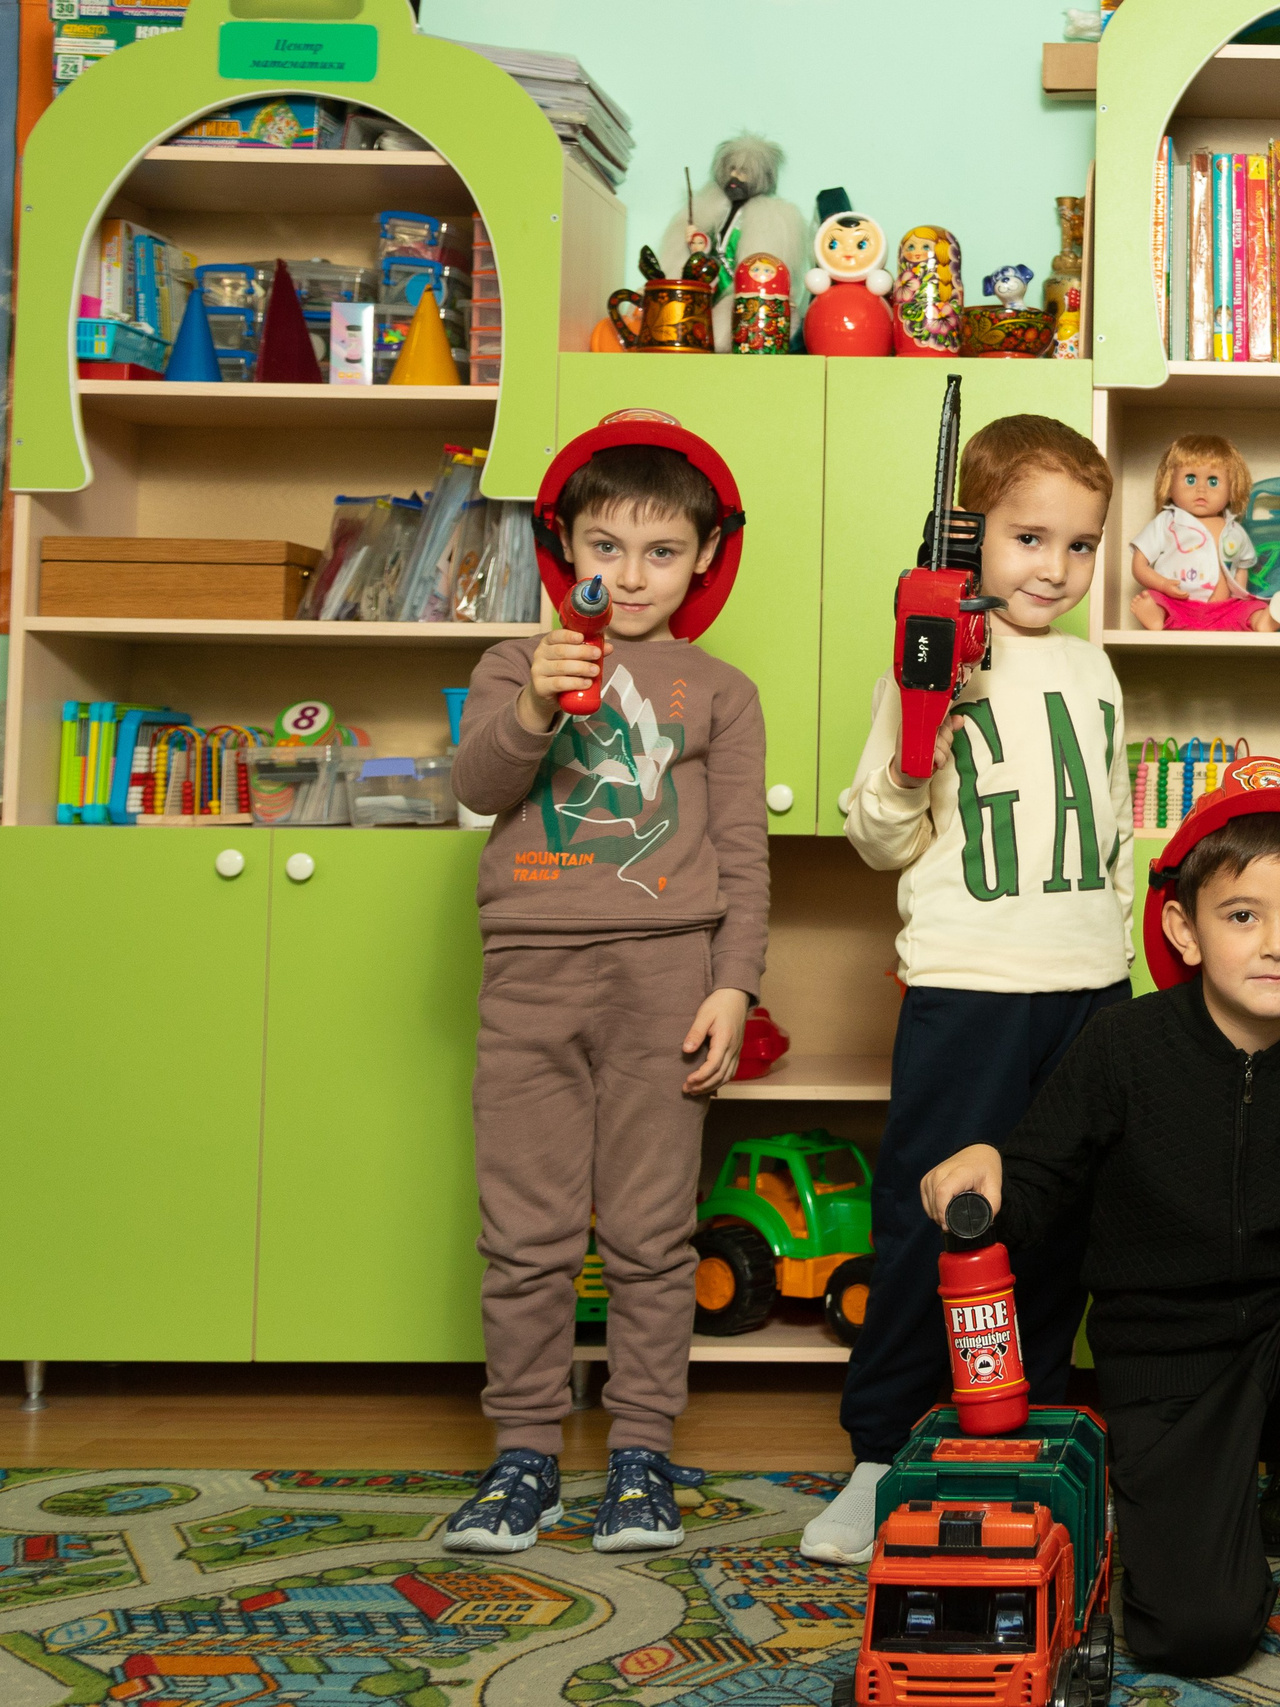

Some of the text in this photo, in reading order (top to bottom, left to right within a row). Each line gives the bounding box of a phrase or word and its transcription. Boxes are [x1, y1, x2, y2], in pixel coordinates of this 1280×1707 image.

[273, 39, 324, 55] Центр
[60, 63, 78, 74] 24
[249, 59, 346, 70] математики
[1153, 160, 1165, 222] ПИСАТЕЛЕЙ
[1233, 208, 1244, 354] Редьярд Киплинг Сказки
[292, 705, 320, 731] 8
[949, 691, 1121, 903] GA
[514, 850, 595, 867] MOUNTAIN
[512, 867, 560, 882] TRAILS
[950, 1300, 1009, 1333] FIRE
[954, 1330, 1011, 1349] extinguisher
